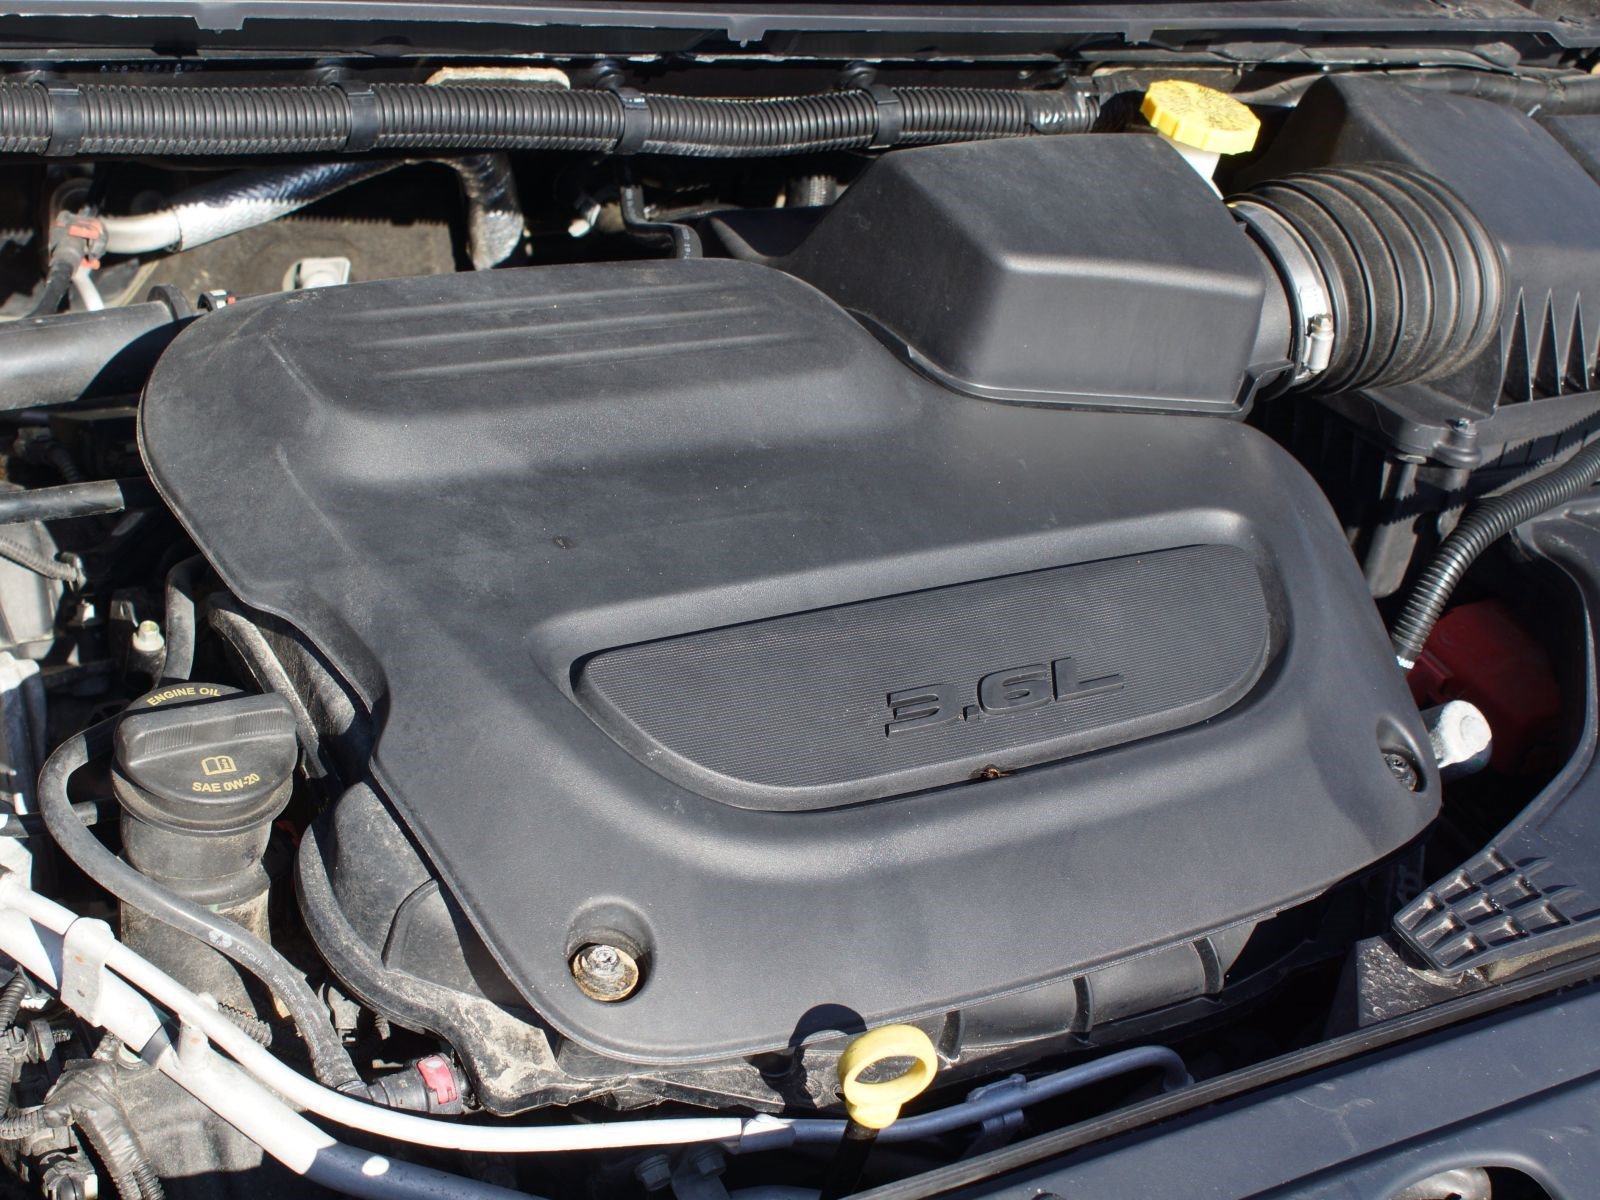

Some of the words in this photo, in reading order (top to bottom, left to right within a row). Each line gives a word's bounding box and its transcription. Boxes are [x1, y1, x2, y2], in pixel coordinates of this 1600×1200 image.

[147, 687, 196, 706] ENGINE
[199, 687, 221, 697] OIL
[884, 656, 1124, 738] 3.6L
[192, 782, 222, 792] SAE
[223, 773, 260, 791] 0W-20
